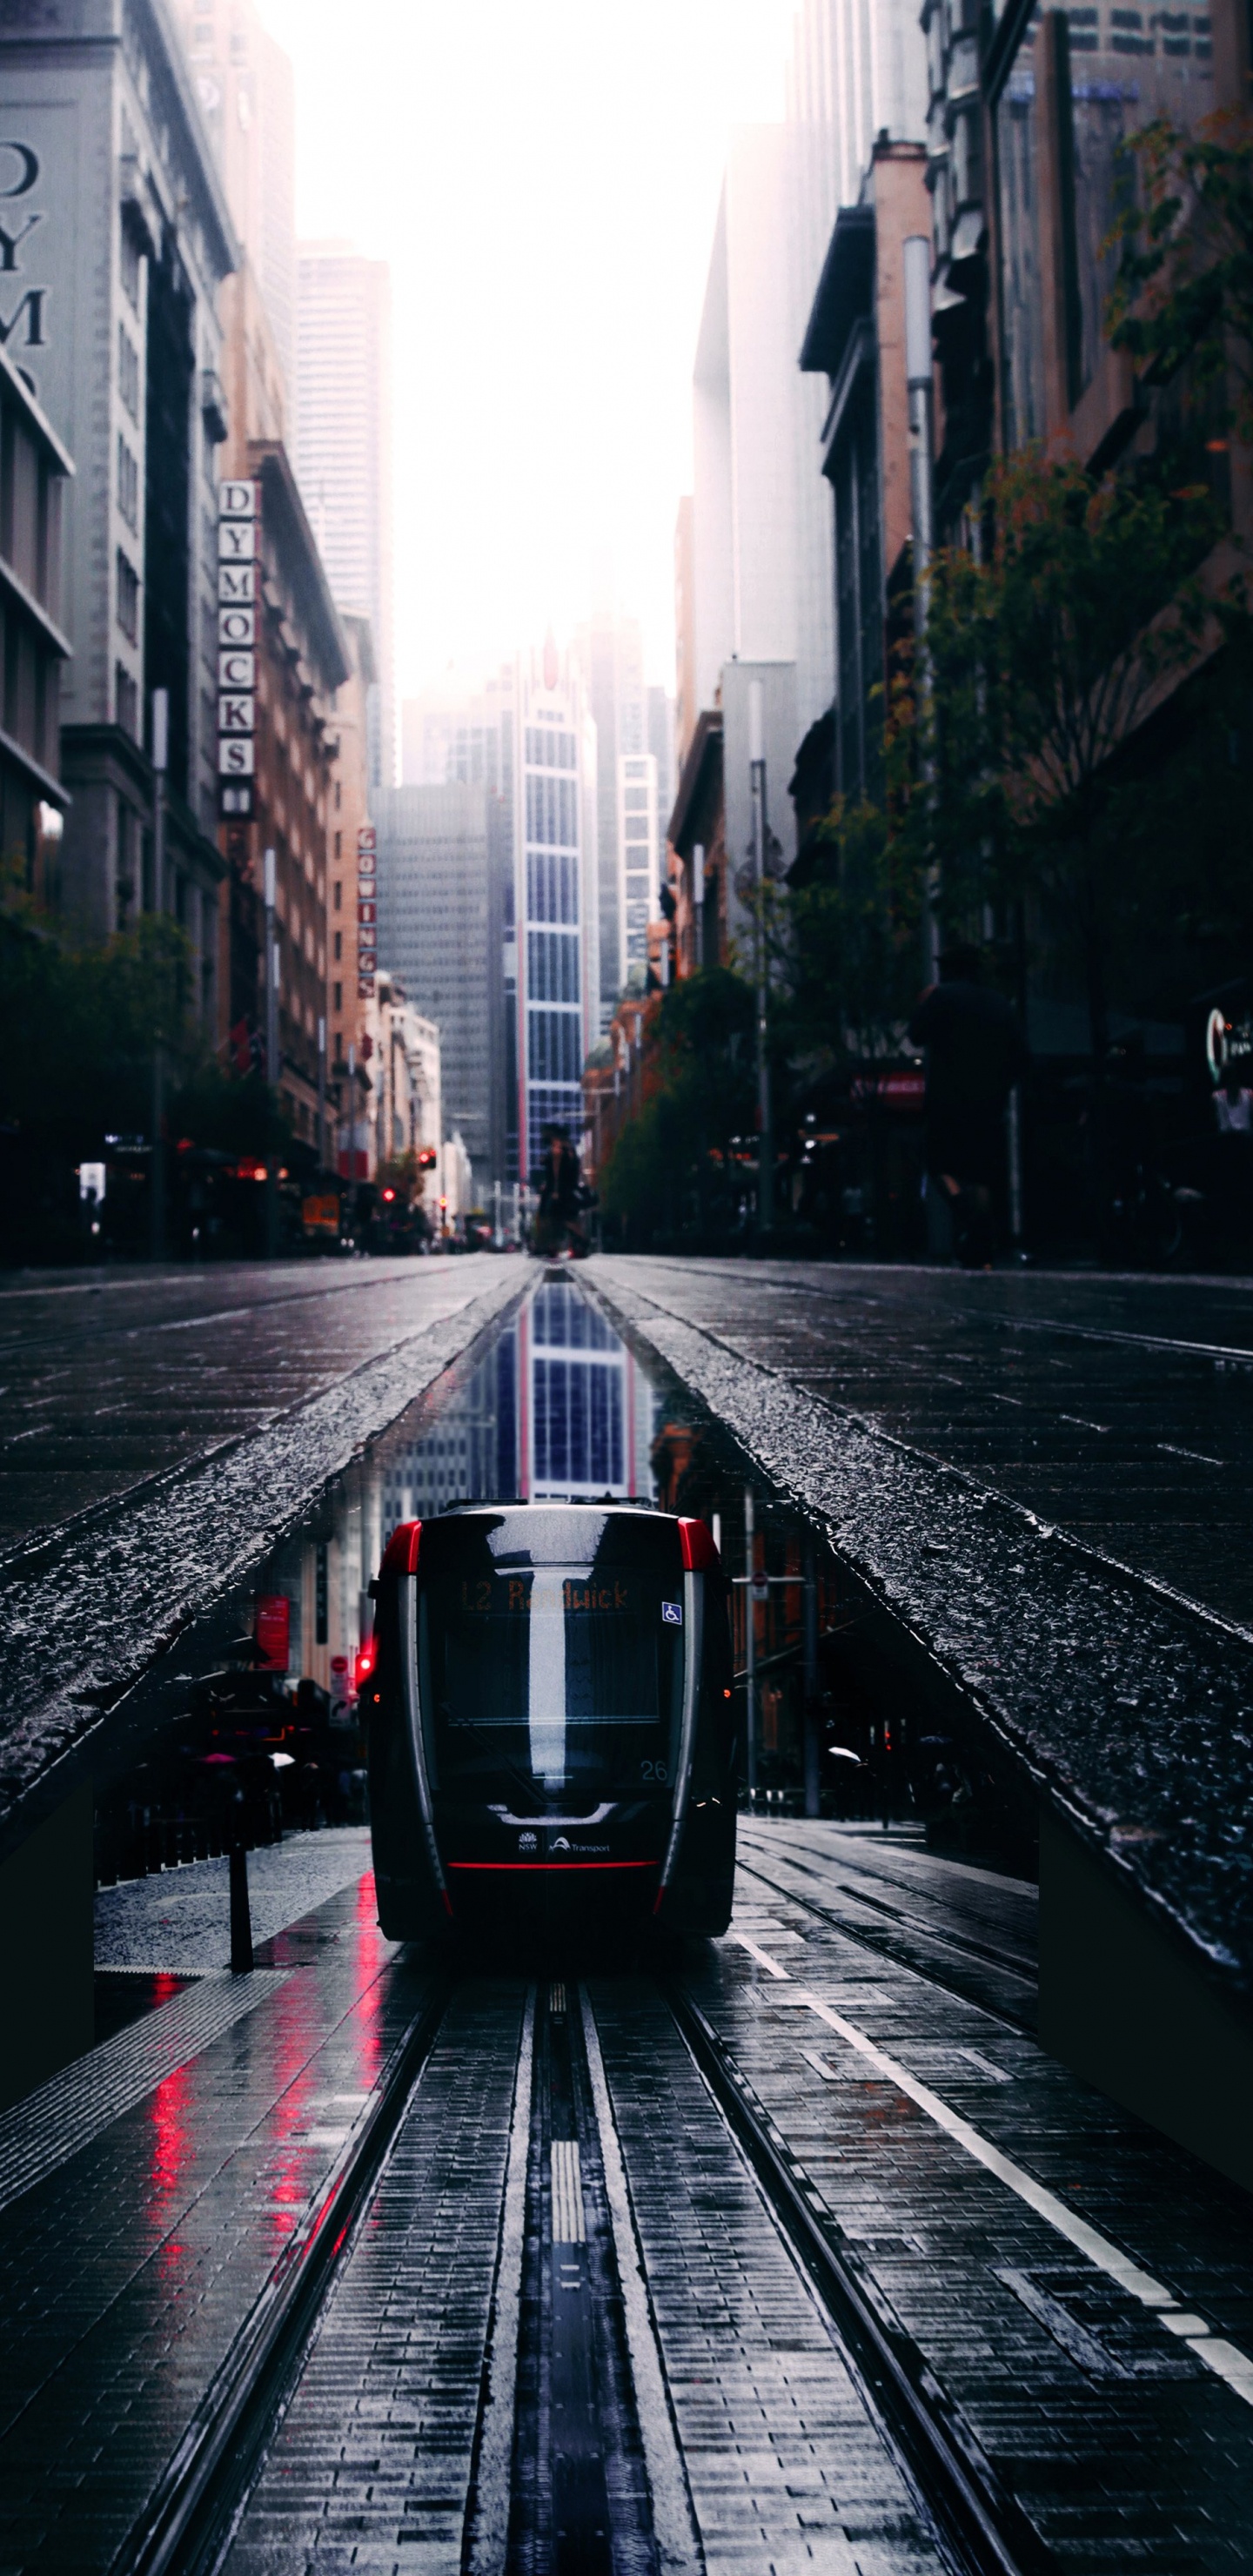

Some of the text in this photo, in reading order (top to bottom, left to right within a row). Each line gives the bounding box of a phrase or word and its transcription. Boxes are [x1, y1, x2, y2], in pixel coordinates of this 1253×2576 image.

[223, 485, 252, 773] DYMOCKS
[358, 828, 376, 997] GOWINGS
[460, 1580, 627, 1610] L2 Randwick
[640, 1760, 667, 1781] 26
[519, 1842, 538, 1852] NSW
[571, 1843, 610, 1853] Transport
